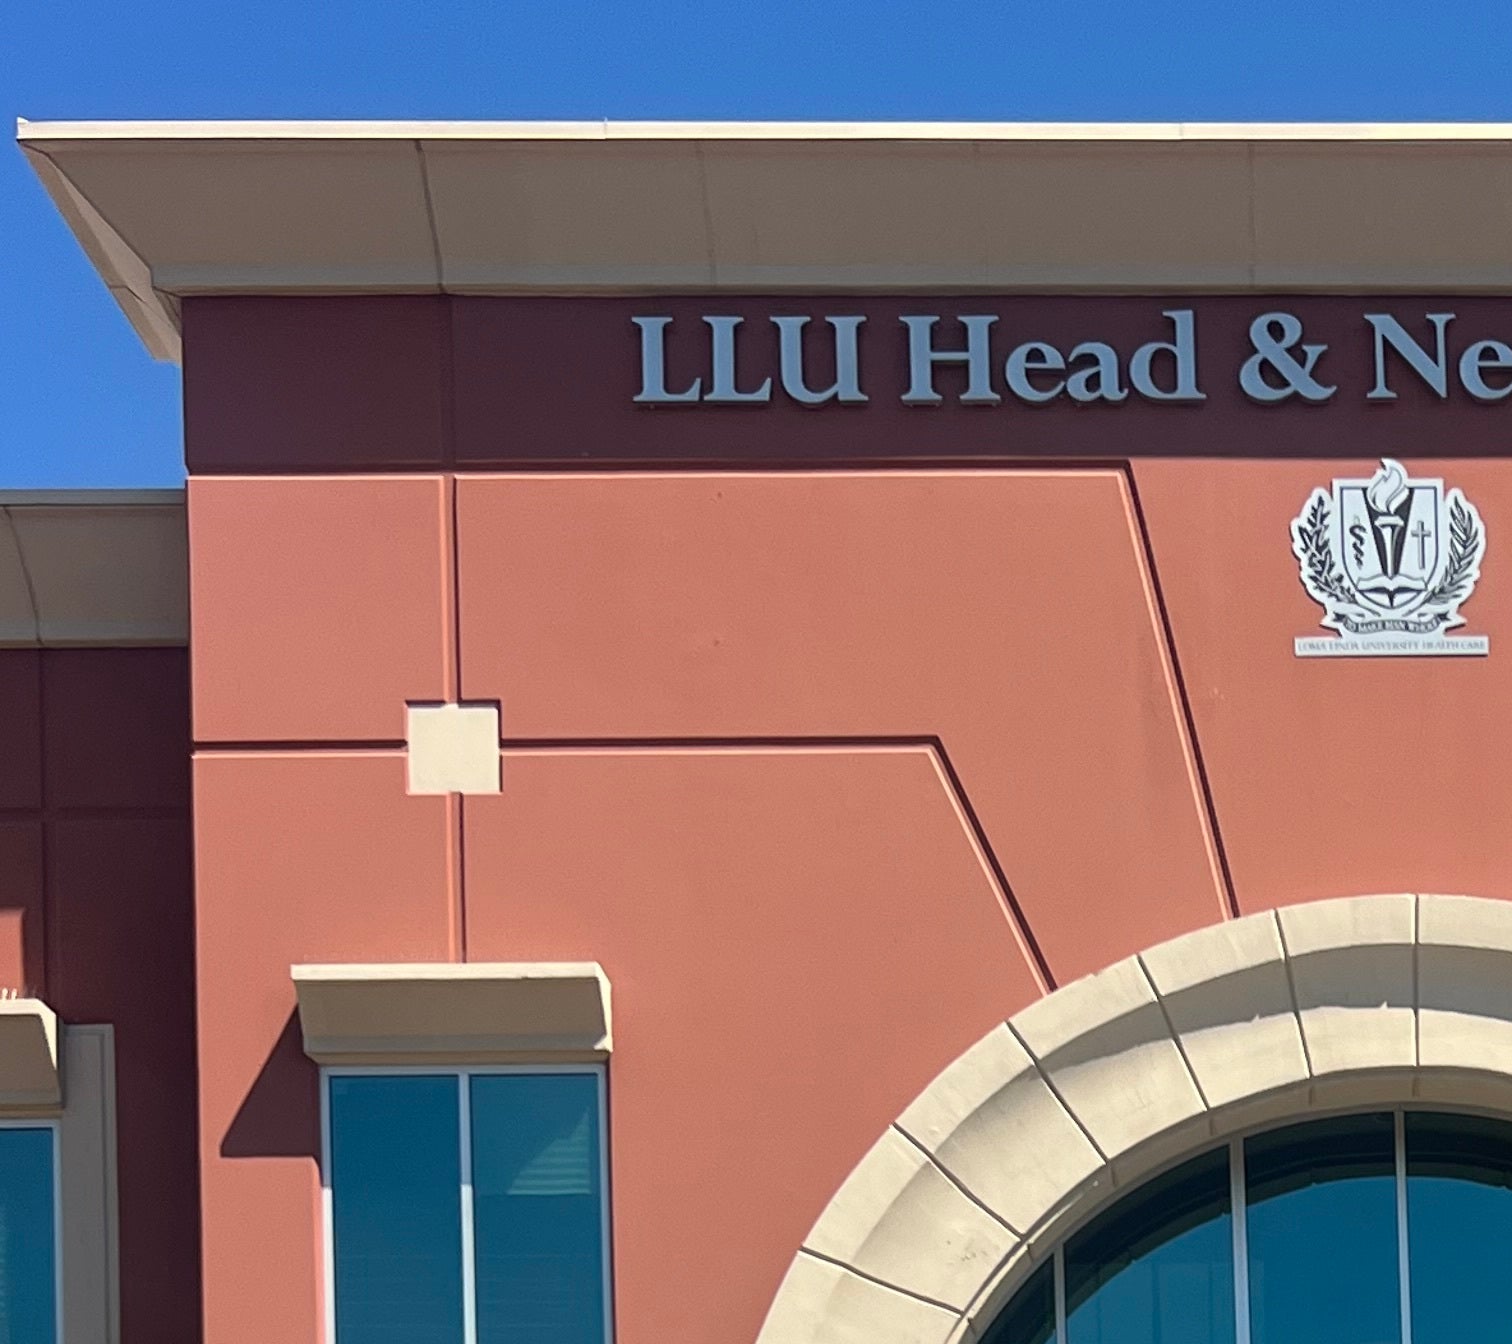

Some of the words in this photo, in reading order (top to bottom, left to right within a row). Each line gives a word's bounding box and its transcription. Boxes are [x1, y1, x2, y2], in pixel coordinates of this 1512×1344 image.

[632, 316, 868, 402] LLU
[899, 310, 1206, 401] Head
[1240, 313, 1336, 400] &
